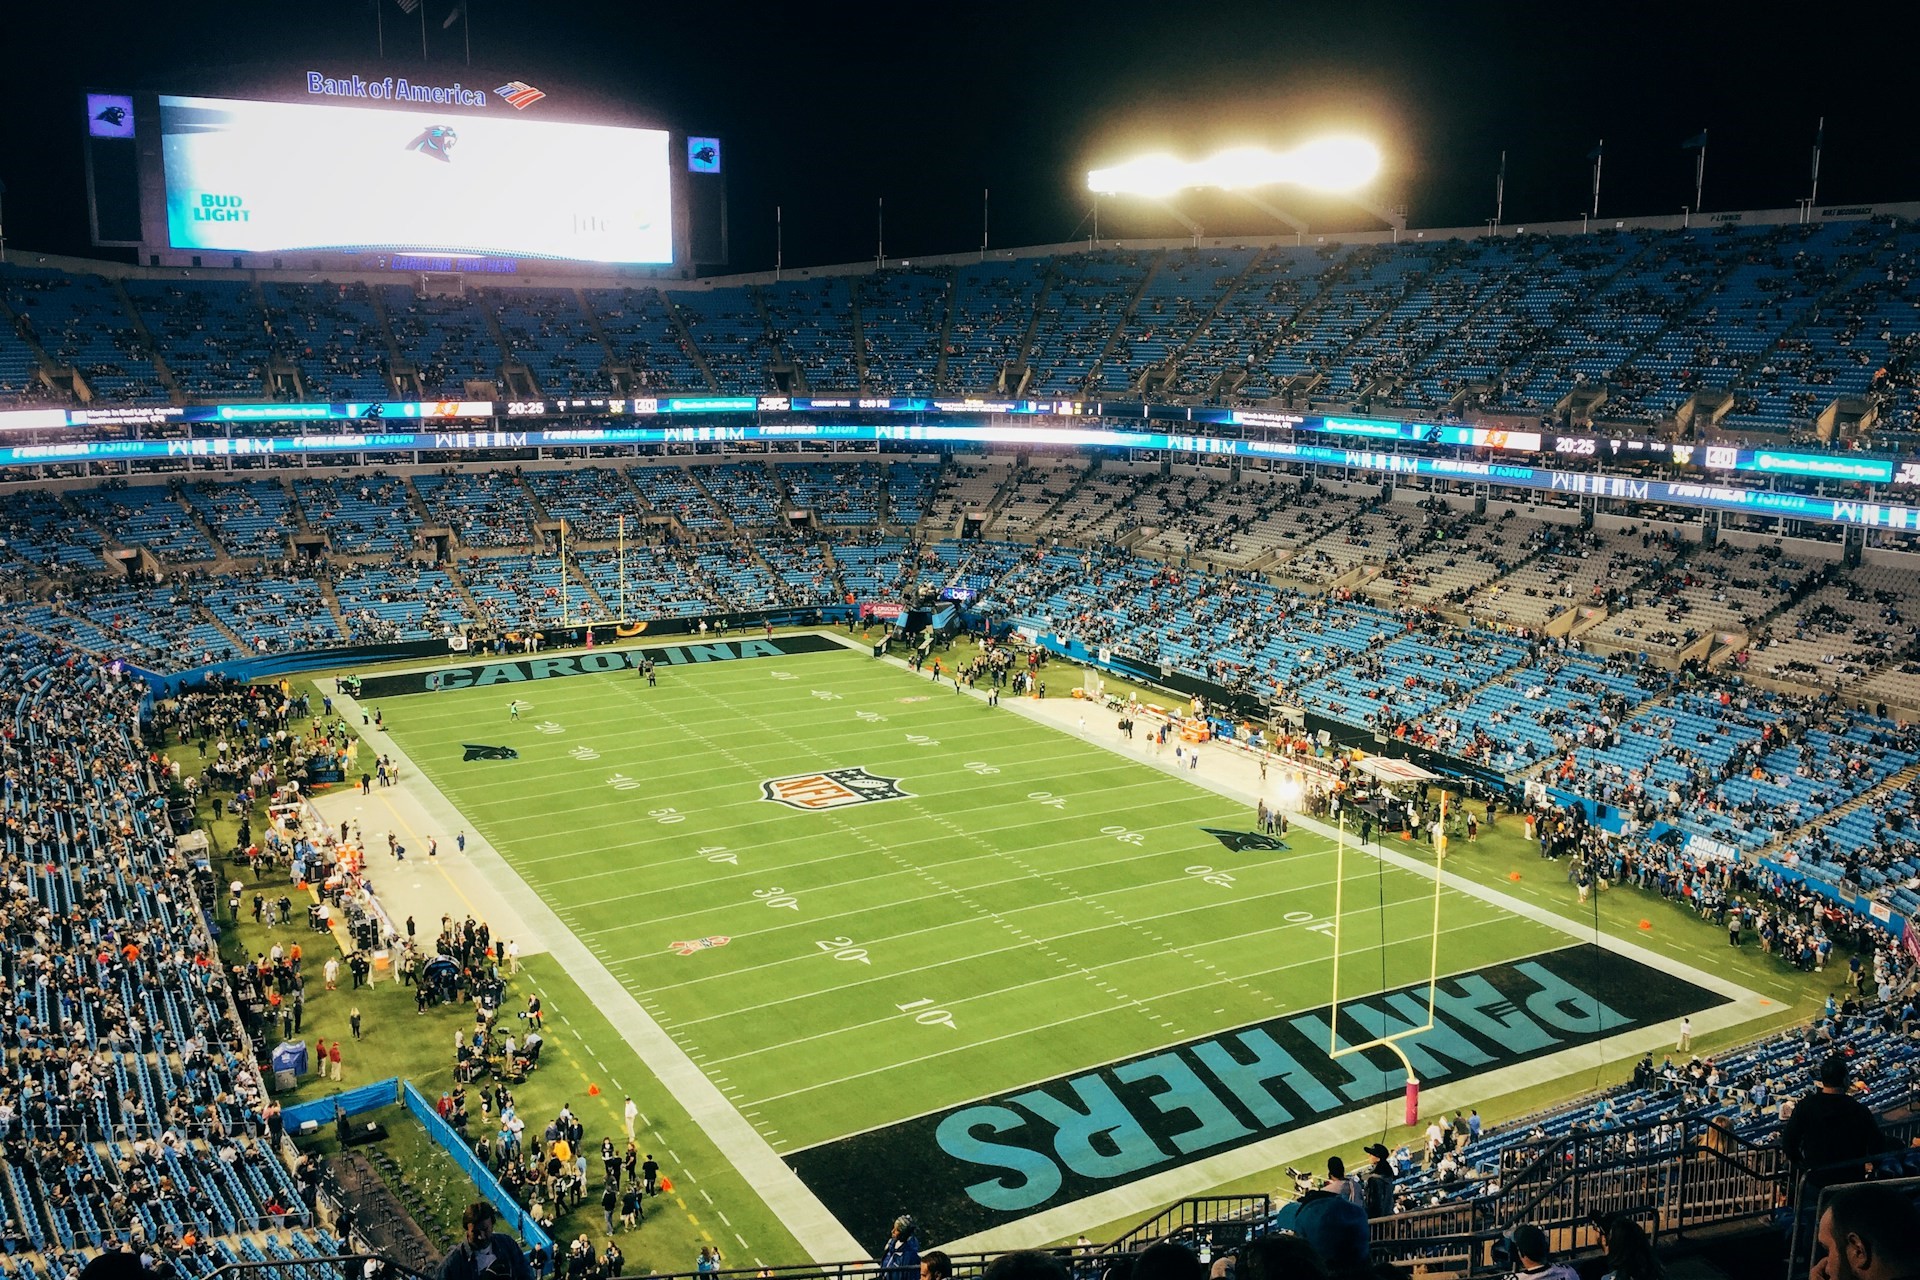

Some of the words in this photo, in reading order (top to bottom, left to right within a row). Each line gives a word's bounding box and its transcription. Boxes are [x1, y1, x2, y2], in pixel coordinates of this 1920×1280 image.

[307, 71, 367, 97] Bank
[369, 77, 393, 99] of
[395, 78, 487, 106] America
[201, 193, 243, 208] BUD
[193, 207, 251, 222] LIGHT
[392, 255, 452, 271] CAROLINA
[456, 257, 517, 273] PANTHERS
[507, 401, 545, 415] 20:25
[1555, 437, 1595, 455] 20:25
[425, 640, 786, 691] CAROLINA
[776, 775, 855, 808] NFL
[648, 807, 686, 824] 50
[697, 846, 737, 863] 40
[1688, 834, 1735, 860] CAROLINA
[1184, 865, 1236, 884] 20
[752, 887, 797, 908] 30
[816, 936, 868, 961] 20
[895, 998, 953, 1025] 10
[936, 962, 1637, 1211] PANTHERS
